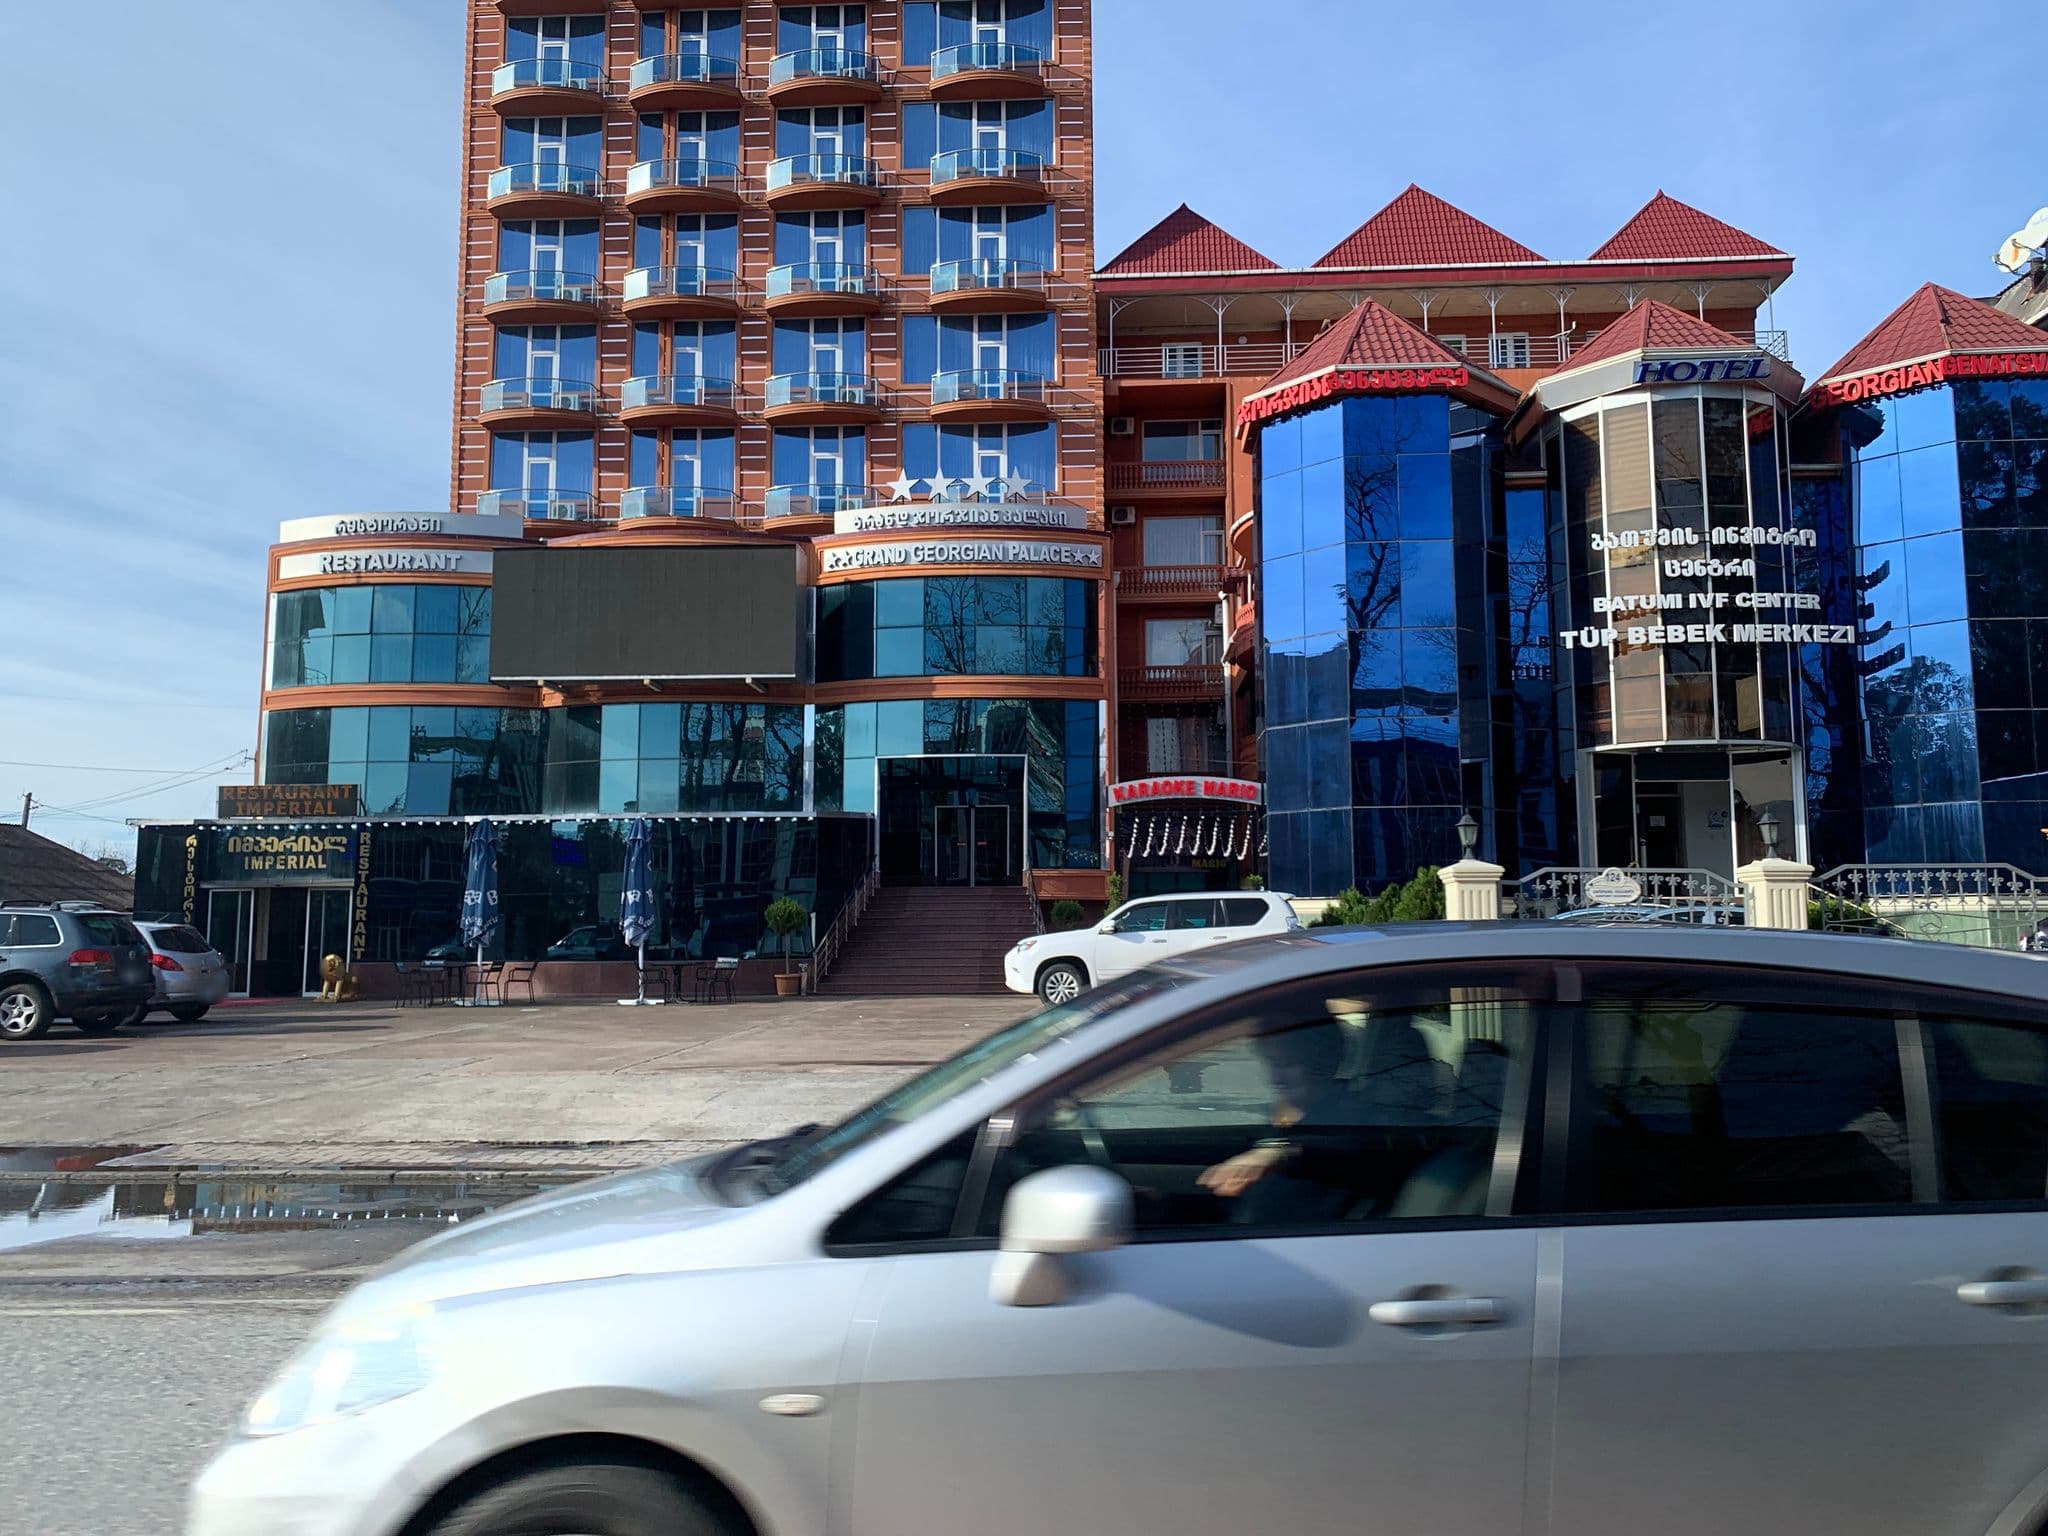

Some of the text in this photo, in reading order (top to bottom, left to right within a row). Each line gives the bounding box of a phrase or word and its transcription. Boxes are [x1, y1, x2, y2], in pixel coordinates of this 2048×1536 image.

[1635, 358, 1770, 384] HOTEL
[1942, 352, 2048, 375] GENATSV
[1329, 367, 1469, 389] გენაცვალე
[335, 517, 442, 535] რესტორანი
[913, 509, 998, 526] ჯორჯიან
[1003, 508, 1068, 526] პალასი
[1591, 526, 1817, 550] ბათუმის ინვიტრო
[320, 552, 462, 573] RESTAURANT
[853, 543, 1072, 567] GRAND GEORGIAN PALACE
[1664, 558, 1756, 577] ცენტრი
[1592, 592, 1821, 613] BATUMI IVF CENTER
[1560, 625, 1618, 649] TÜP
[1627, 623, 1727, 645] BEBEK
[223, 784, 353, 801] RESTAURANT
[1113, 779, 1259, 803] KARAOKE MARIO
[235, 799, 337, 816] IMPERIAL
[228, 835, 348, 854] იმპერიალ
[244, 854, 327, 871] IMPERIAL
[183, 833, 198, 925] რესტორა
[354, 831, 372, 960] RESTAURANT
